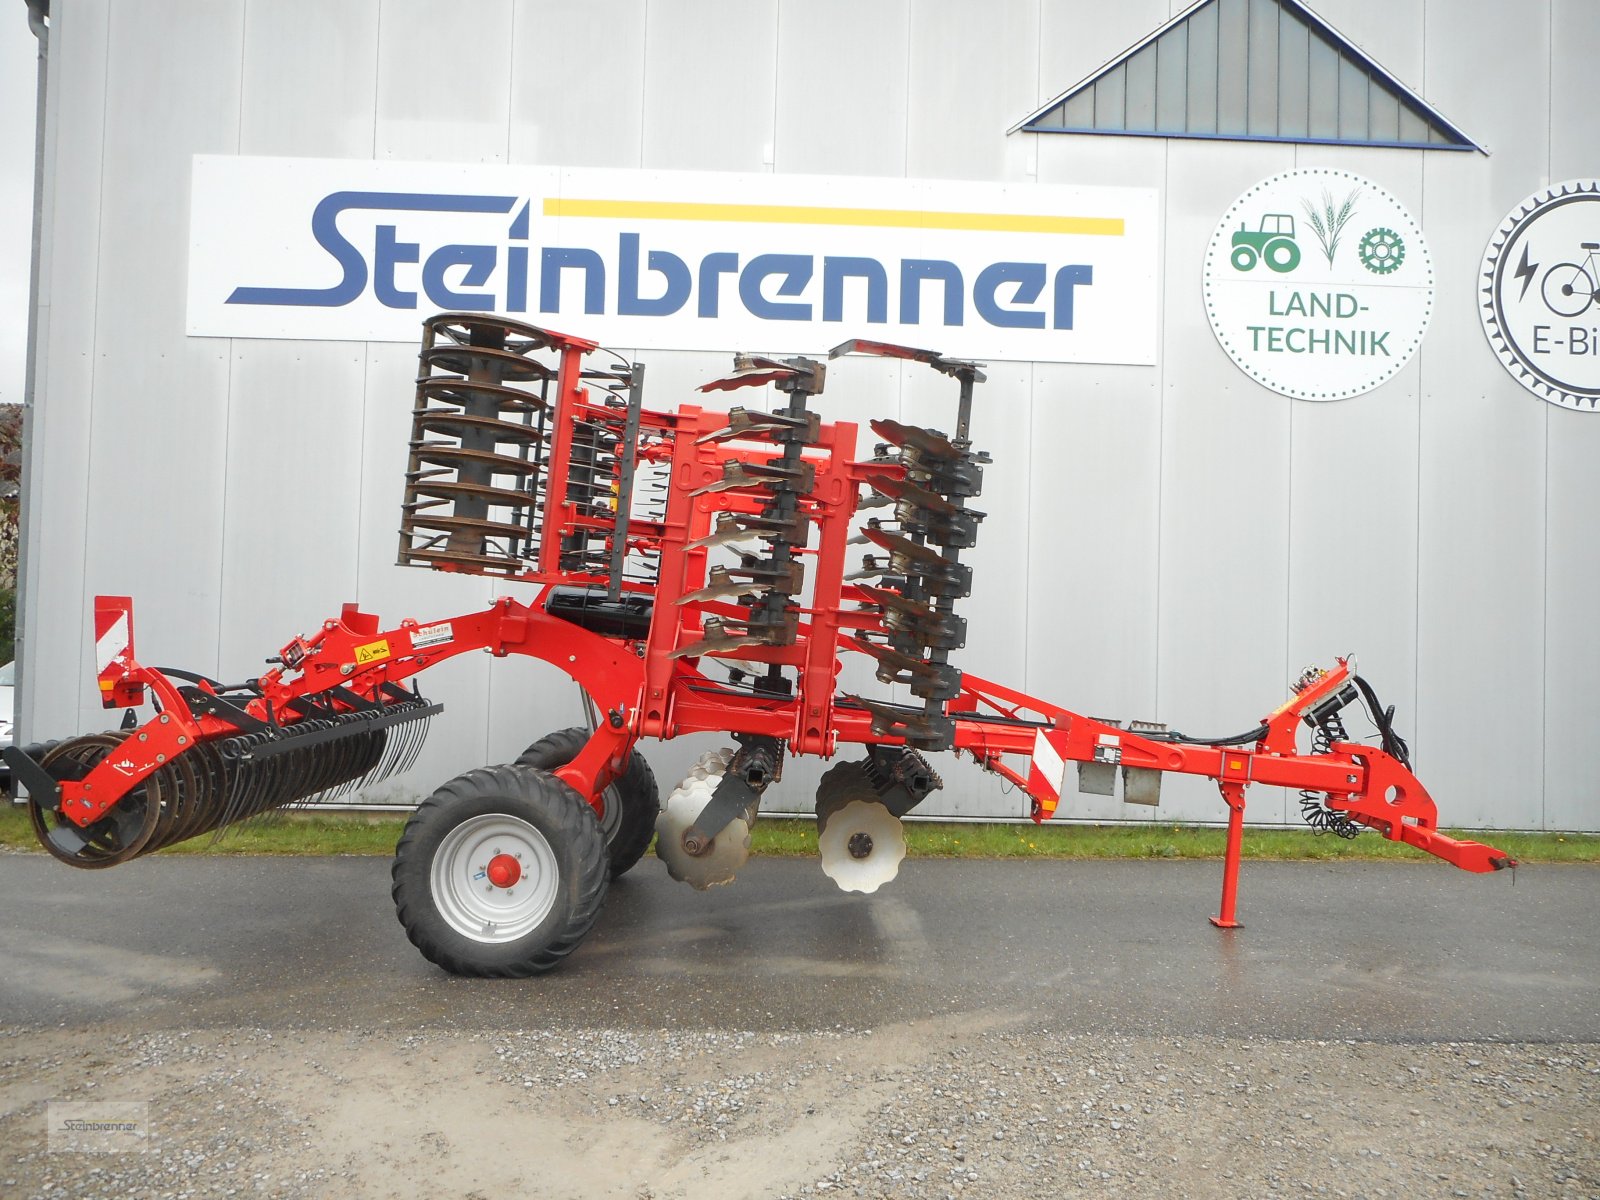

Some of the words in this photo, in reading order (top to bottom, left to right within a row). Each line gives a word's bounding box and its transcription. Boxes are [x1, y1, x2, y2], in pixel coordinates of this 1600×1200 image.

[224, 191, 1093, 330] Steinbrenner
[1269, 291, 1370, 318] LAND-
[1247, 326, 1391, 356] TECHNIK
